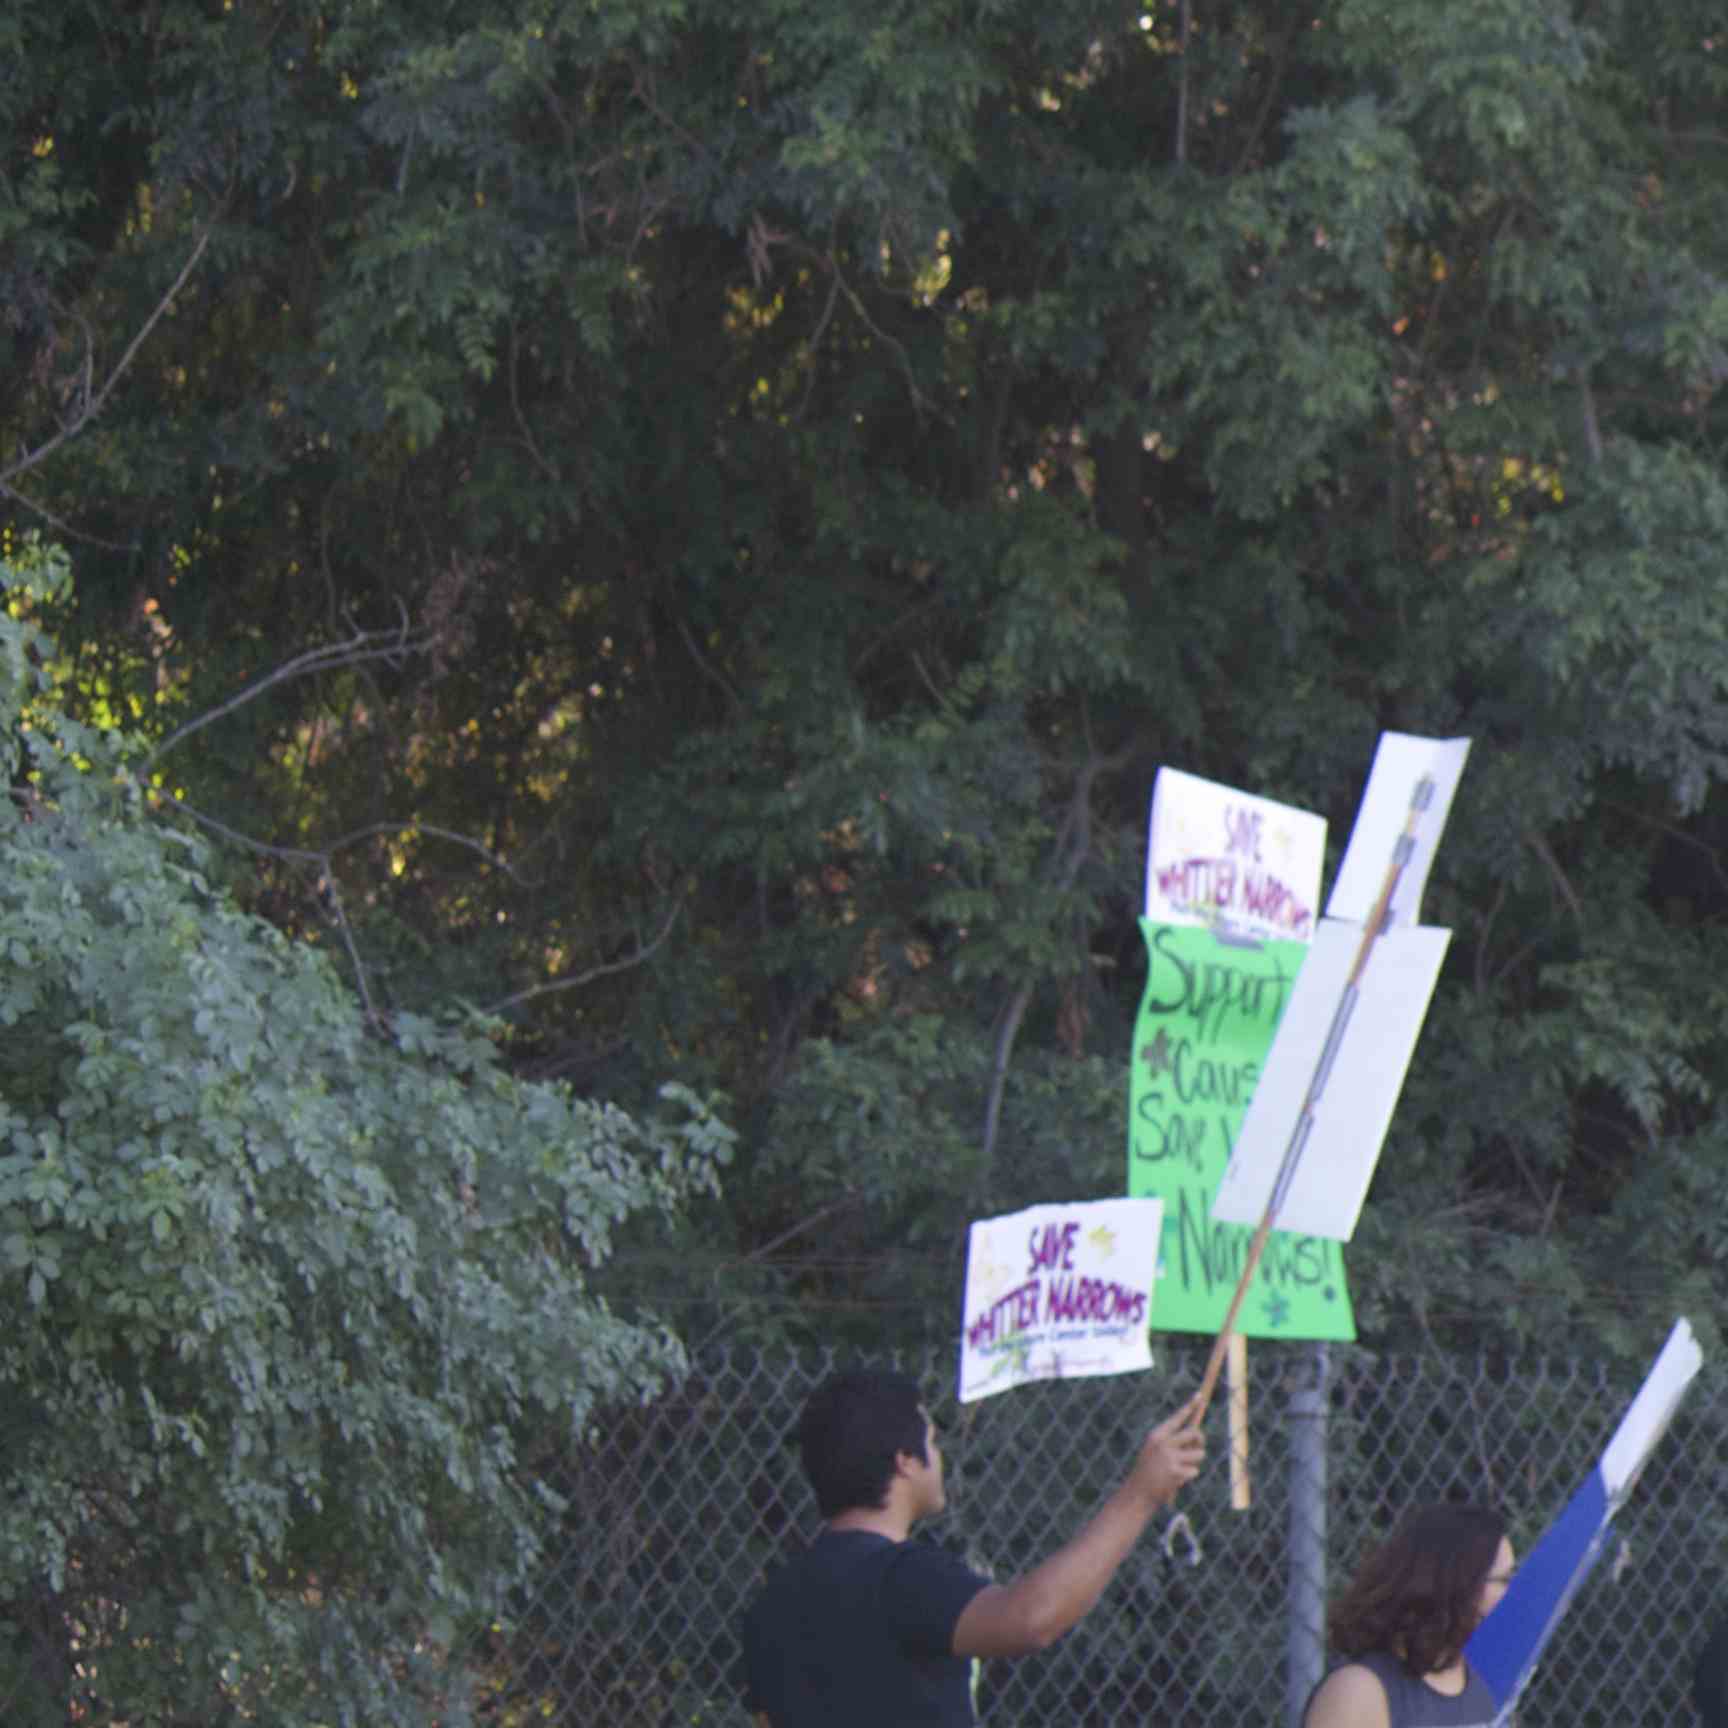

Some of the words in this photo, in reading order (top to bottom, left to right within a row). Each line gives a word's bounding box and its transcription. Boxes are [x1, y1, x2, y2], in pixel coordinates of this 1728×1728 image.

[1225, 804, 1264, 863] SAVE
[1148, 927, 1294, 1045] Support
[1028, 1221, 1080, 1276] SAVE
[1045, 1273, 1148, 1326] NARROWS
